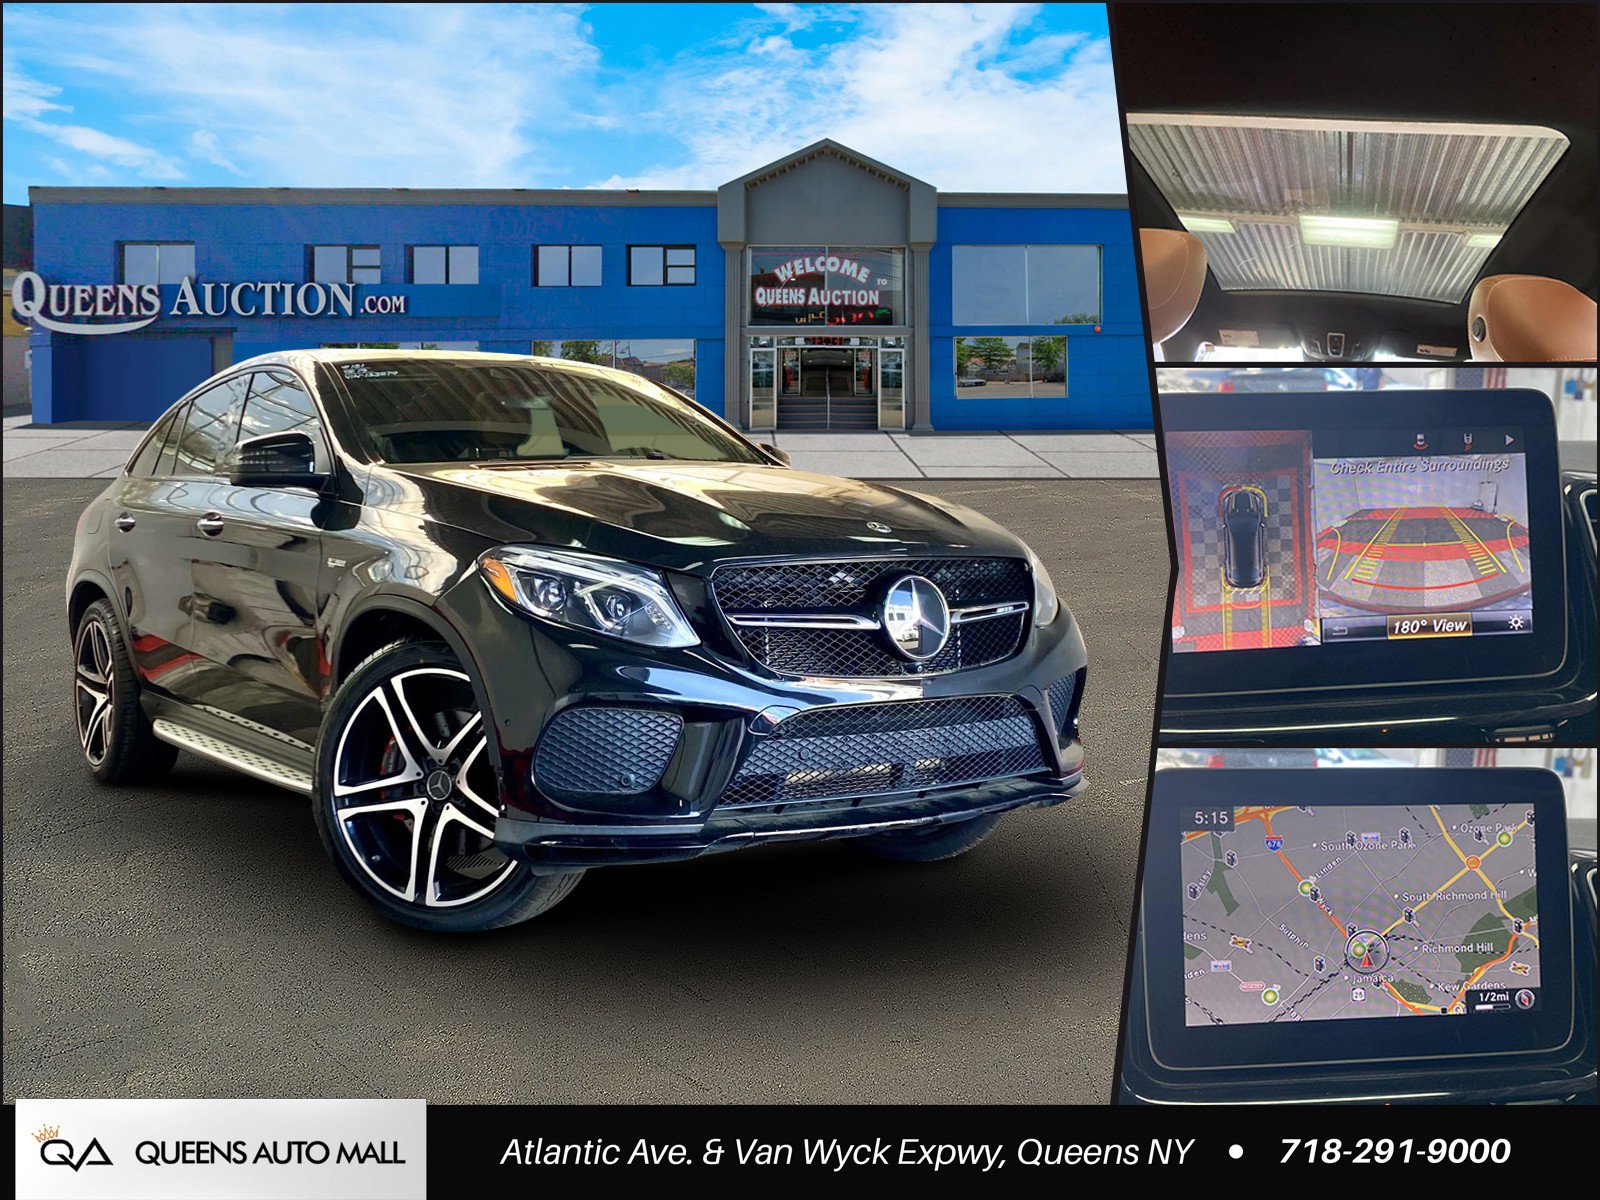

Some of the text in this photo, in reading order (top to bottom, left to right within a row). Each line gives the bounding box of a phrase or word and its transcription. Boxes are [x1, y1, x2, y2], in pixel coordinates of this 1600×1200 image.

[773, 255, 871, 283] WELCOME
[755, 286, 880, 306] QUEENS AUCTION
[12, 271, 160, 335] QUEENS
[1330, 457, 1510, 475] Check Entire Surroundings
[1394, 618, 1467, 634] 180° View
[1194, 811, 1229, 825] 5:15
[1460, 824, 1517, 833] Ozone Park
[1266, 839, 1282, 847] 678
[1320, 840, 1415, 851] South Ozone Park
[1315, 856, 1342, 878] Linden
[1402, 890, 1507, 902] South Richmond Hill
[1422, 942, 1494, 954] Richmond Hill
[1353, 973, 1394, 984] Jamaica
[1438, 981, 1506, 992] Kew Gardens
[1479, 992, 1510, 1003] 1/2mi
